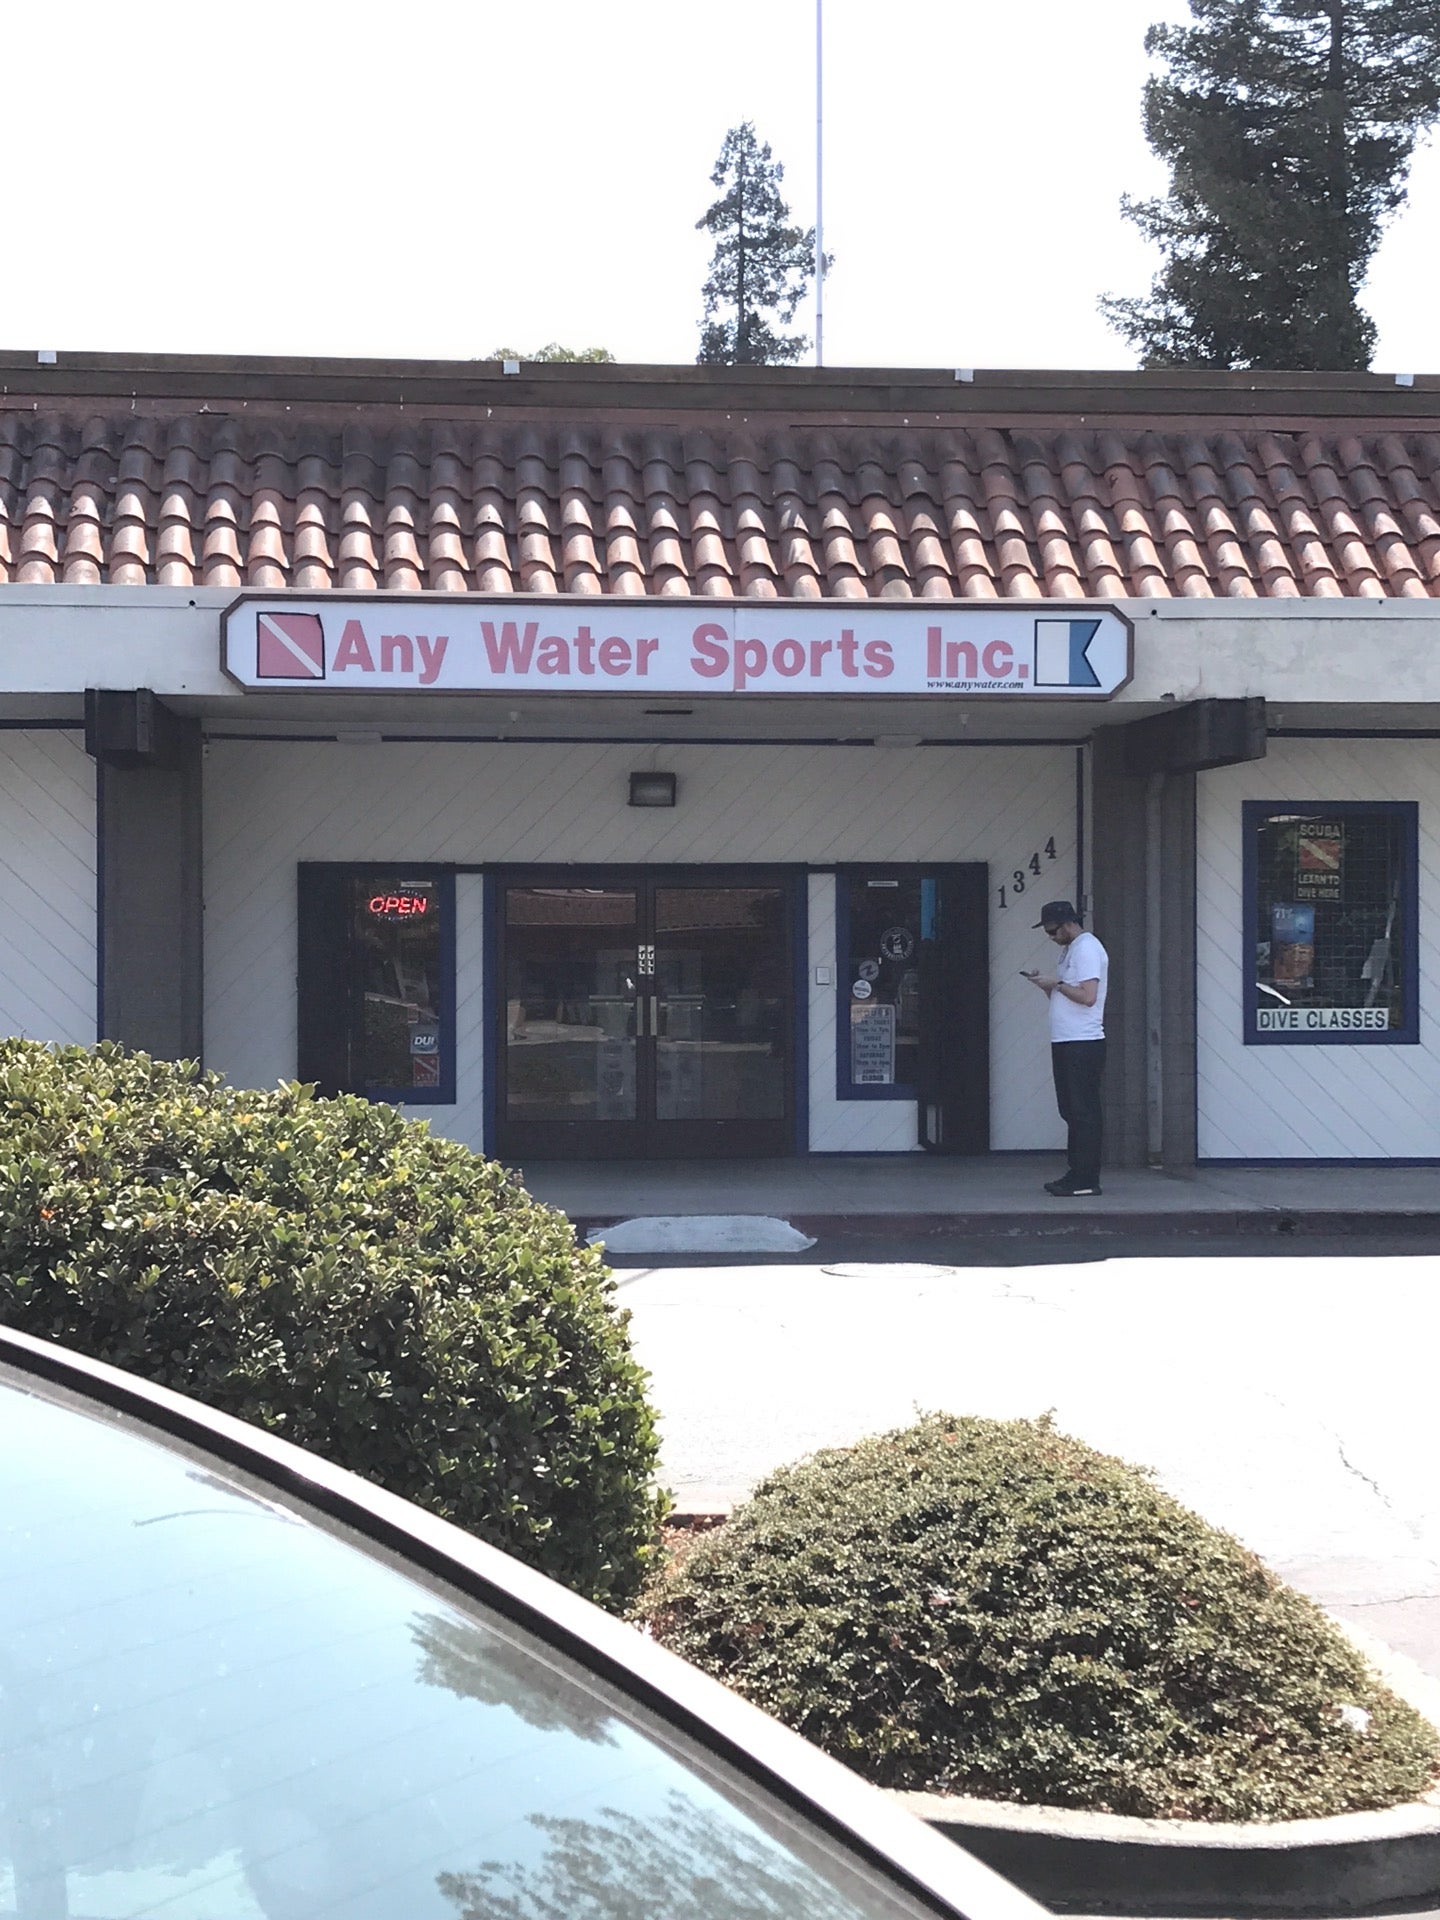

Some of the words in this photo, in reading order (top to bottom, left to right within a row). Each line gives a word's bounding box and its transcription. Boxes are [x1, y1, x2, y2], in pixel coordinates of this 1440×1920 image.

[332, 619, 449, 684] Any
[480, 621, 659, 676] Water
[690, 622, 894, 690] Sports
[927, 626, 1029, 679] Inc.
[927, 680, 1024, 691] www.anywater.com
[1299, 824, 1341, 837] SCUBA
[998, 836, 1057, 909] 1344
[369, 896, 427, 914] OPEN
[1259, 1011, 1299, 1029] DIVE
[1306, 1010, 1386, 1029] CLASSES
